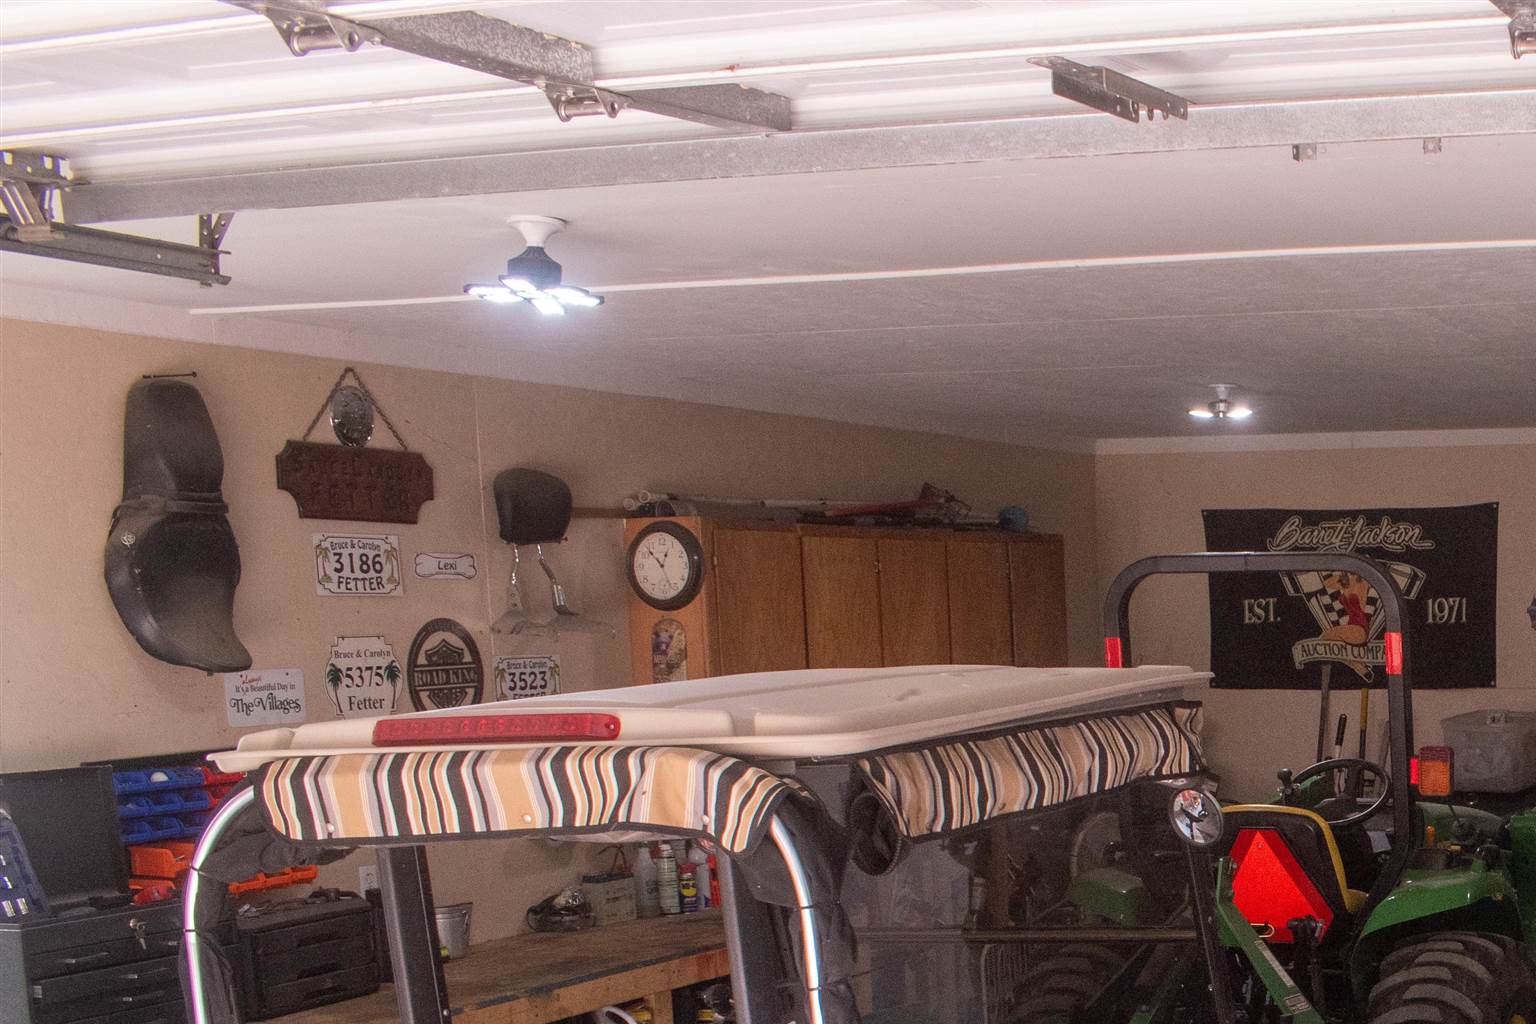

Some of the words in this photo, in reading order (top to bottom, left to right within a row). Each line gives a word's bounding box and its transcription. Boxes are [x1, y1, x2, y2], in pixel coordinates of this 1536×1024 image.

[330, 541, 348, 551] Bruce
[350, 541, 355, 549] &
[357, 540, 381, 551] Carolyn
[333, 552, 384, 575] 3186
[437, 561, 457, 571] Lexi
[337, 576, 385, 591] FETTER
[1243, 598, 1281, 624] EST.
[1426, 597, 1467, 624] 1971
[334, 650, 354, 659] Bruce
[356, 650, 362, 658] &
[364, 649, 391, 659] Carolyn
[1301, 642, 1348, 659] AUCTION
[1352, 644, 1387, 660] COMPA
[345, 666, 385, 688] 5375
[414, 669, 447, 686] ROAD
[449, 668, 479, 684] KING
[508, 671, 548, 691] 3523
[251, 683, 276, 693] Beautiful
[277, 683, 289, 693] Day
[230, 698, 254, 716] The
[255, 692, 302, 715] Villages
[348, 696, 385, 711] Fetter
